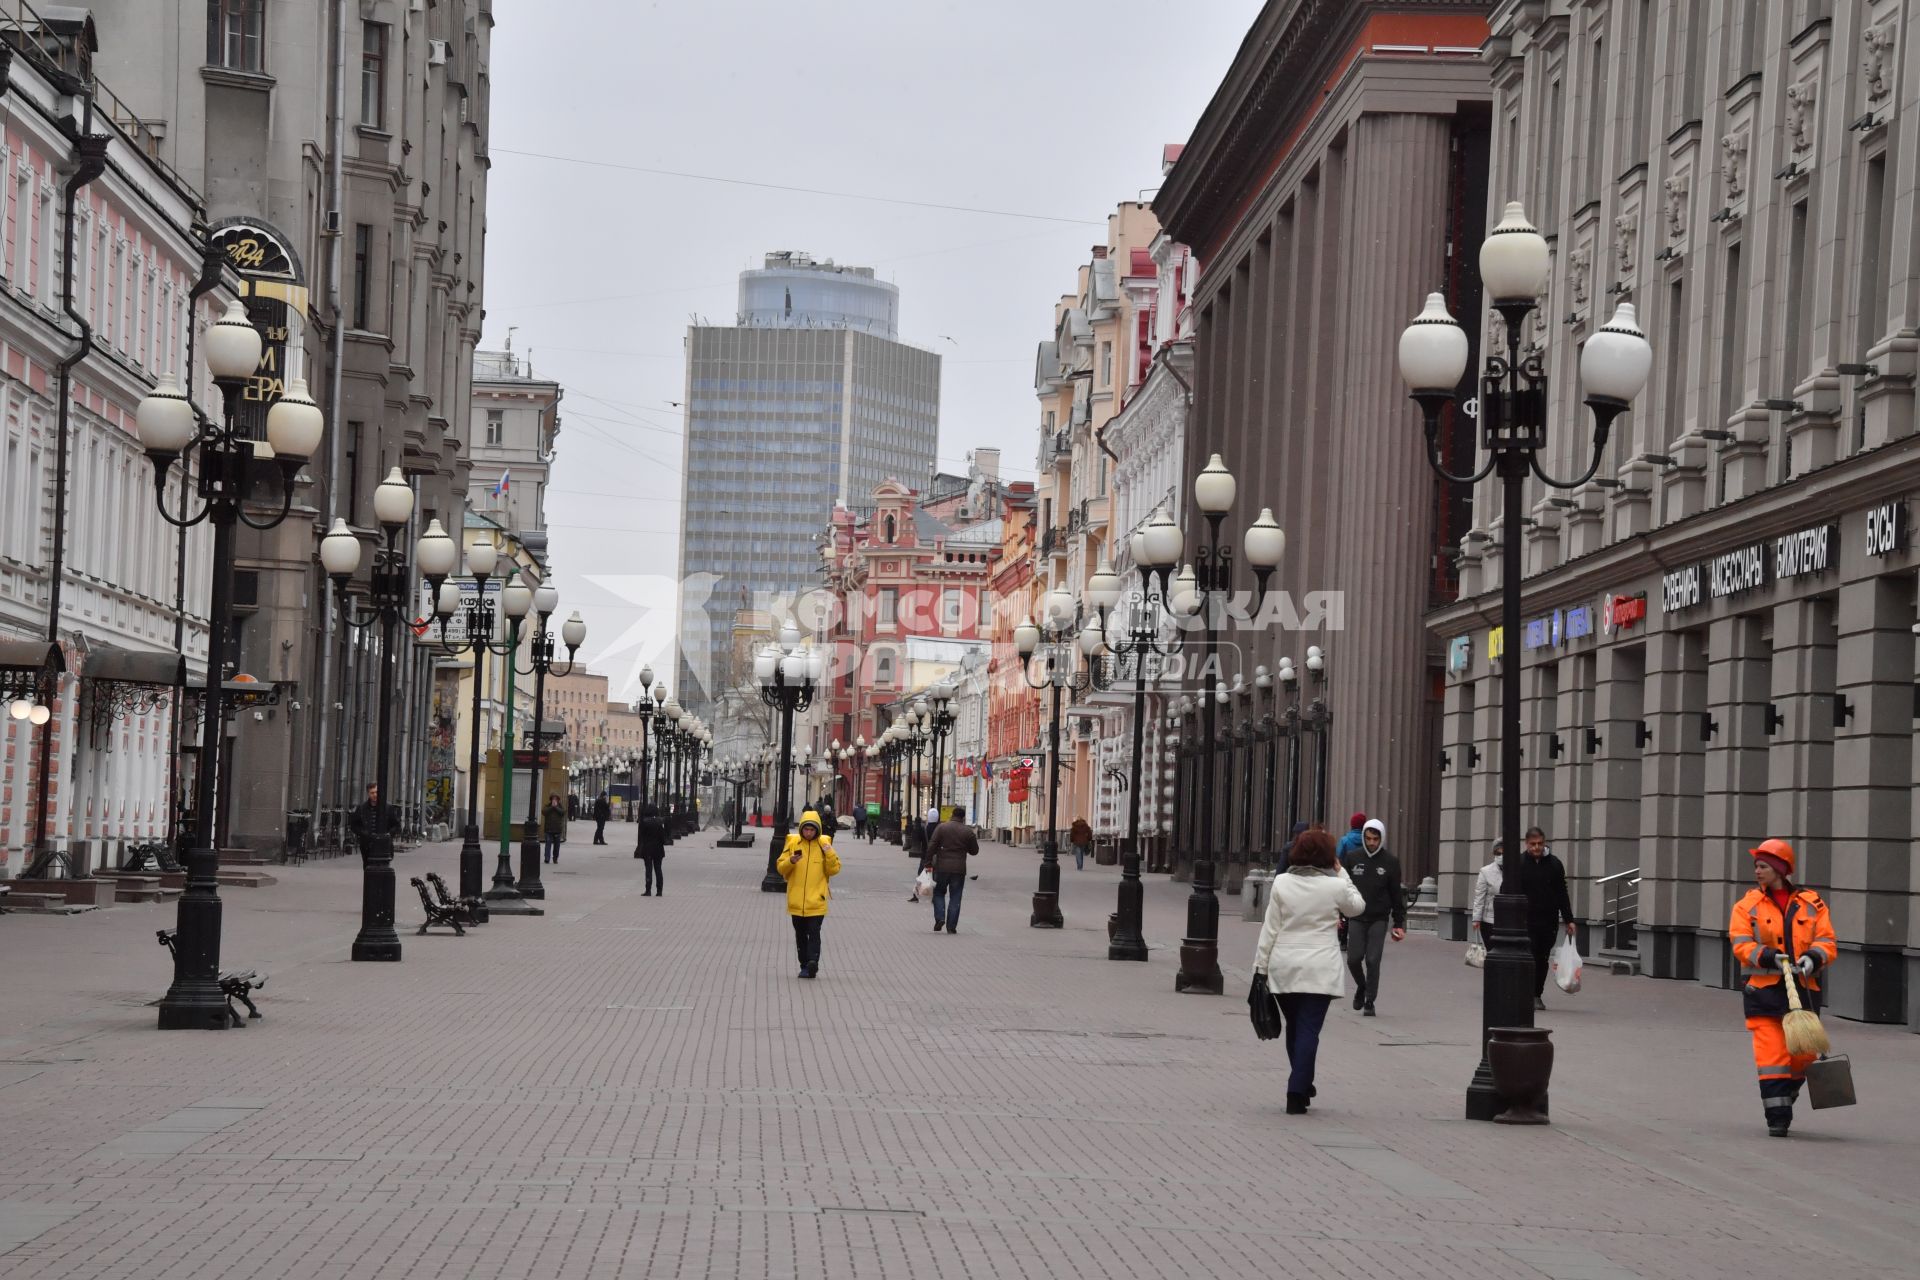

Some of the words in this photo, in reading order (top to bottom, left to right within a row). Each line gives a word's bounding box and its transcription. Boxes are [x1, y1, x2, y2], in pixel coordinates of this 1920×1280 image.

[1662, 565, 1700, 613] СУВЕНИРЫ
[1711, 543, 1763, 599] АКСЕССУАРЫ
[1776, 525, 1828, 579] БИЖУТЕРИЯ
[1866, 503, 1897, 556] БУСЫ
